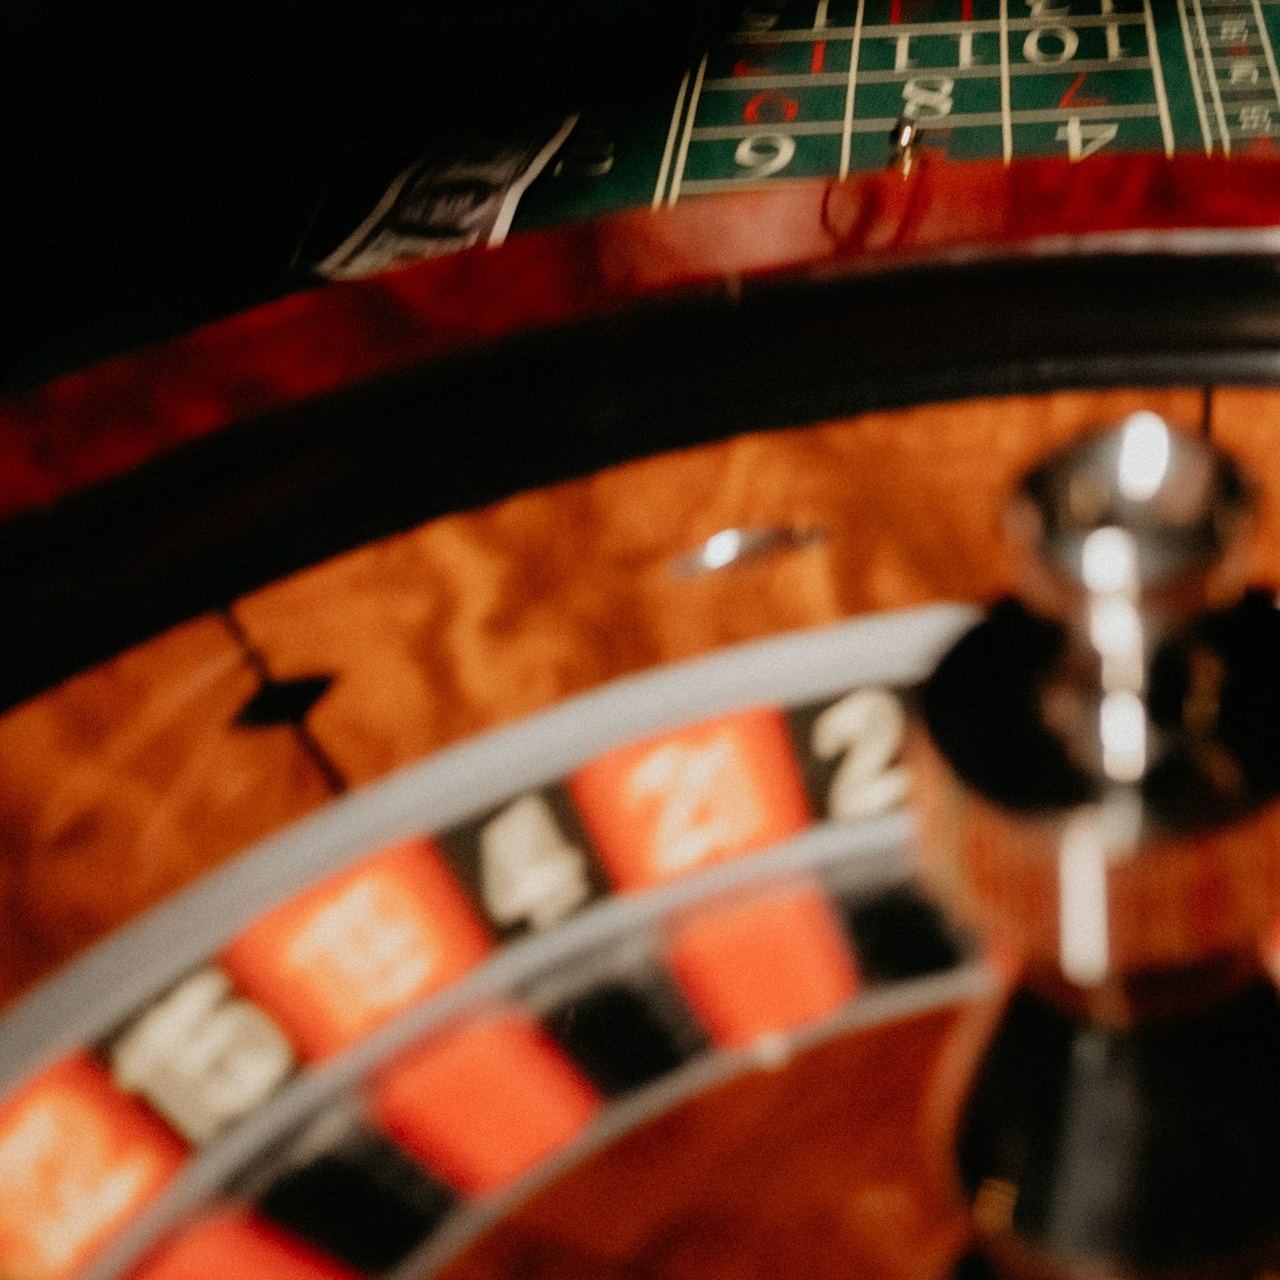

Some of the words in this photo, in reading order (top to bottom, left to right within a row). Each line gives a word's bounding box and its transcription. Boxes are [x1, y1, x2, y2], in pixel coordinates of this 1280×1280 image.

[1021, 23, 1122, 66] 10
[902, 75, 954, 120] 8
[1055, 115, 1120, 164] 4
[816, 687, 910, 820] 2
